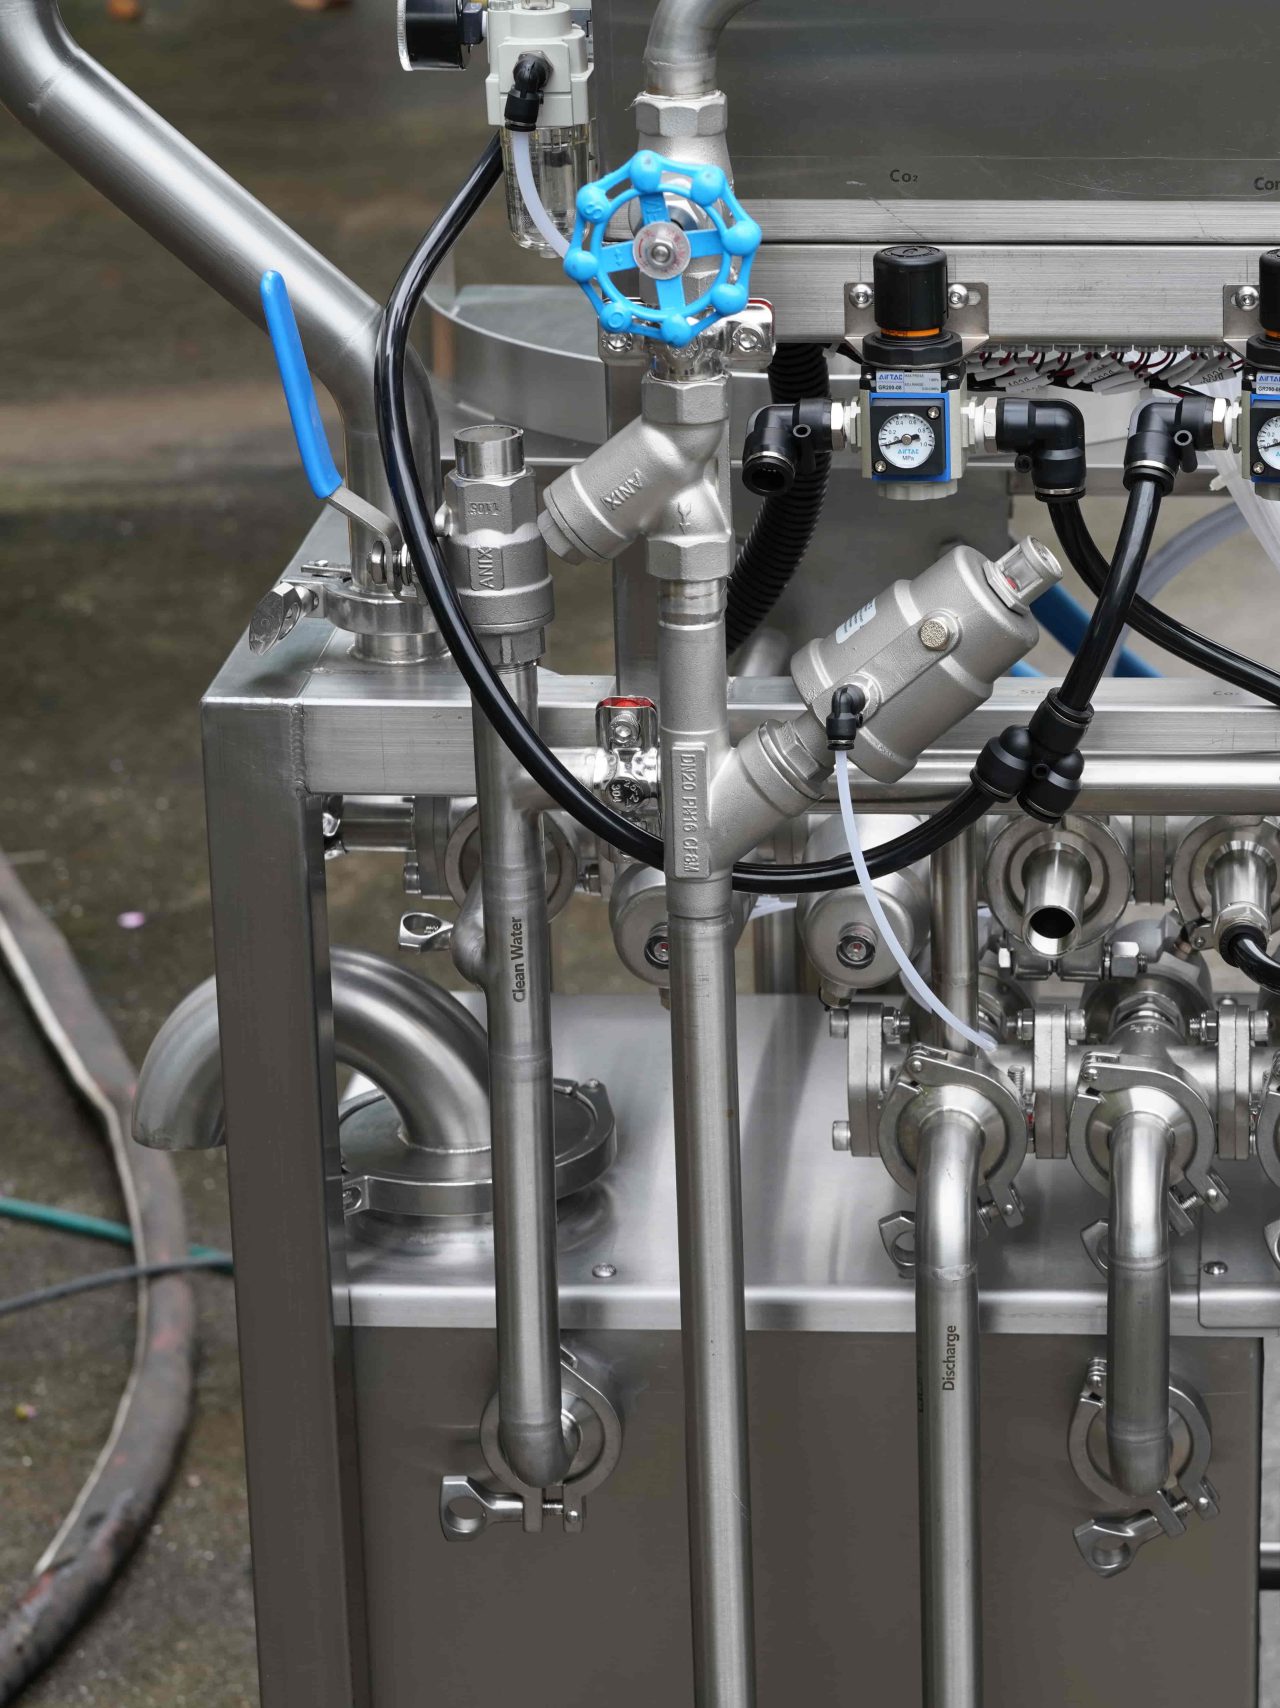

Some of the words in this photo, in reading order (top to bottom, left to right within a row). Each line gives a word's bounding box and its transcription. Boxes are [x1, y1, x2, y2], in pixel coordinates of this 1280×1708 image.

[477, 547, 496, 590] ANIX
[679, 753, 697, 792] DN20
[681, 796, 698, 833] PN16
[682, 837, 700, 873] CF8M
[509, 916, 525, 960] Water
[511, 963, 527, 1003] Clean
[942, 1325, 960, 1391] Discharge
